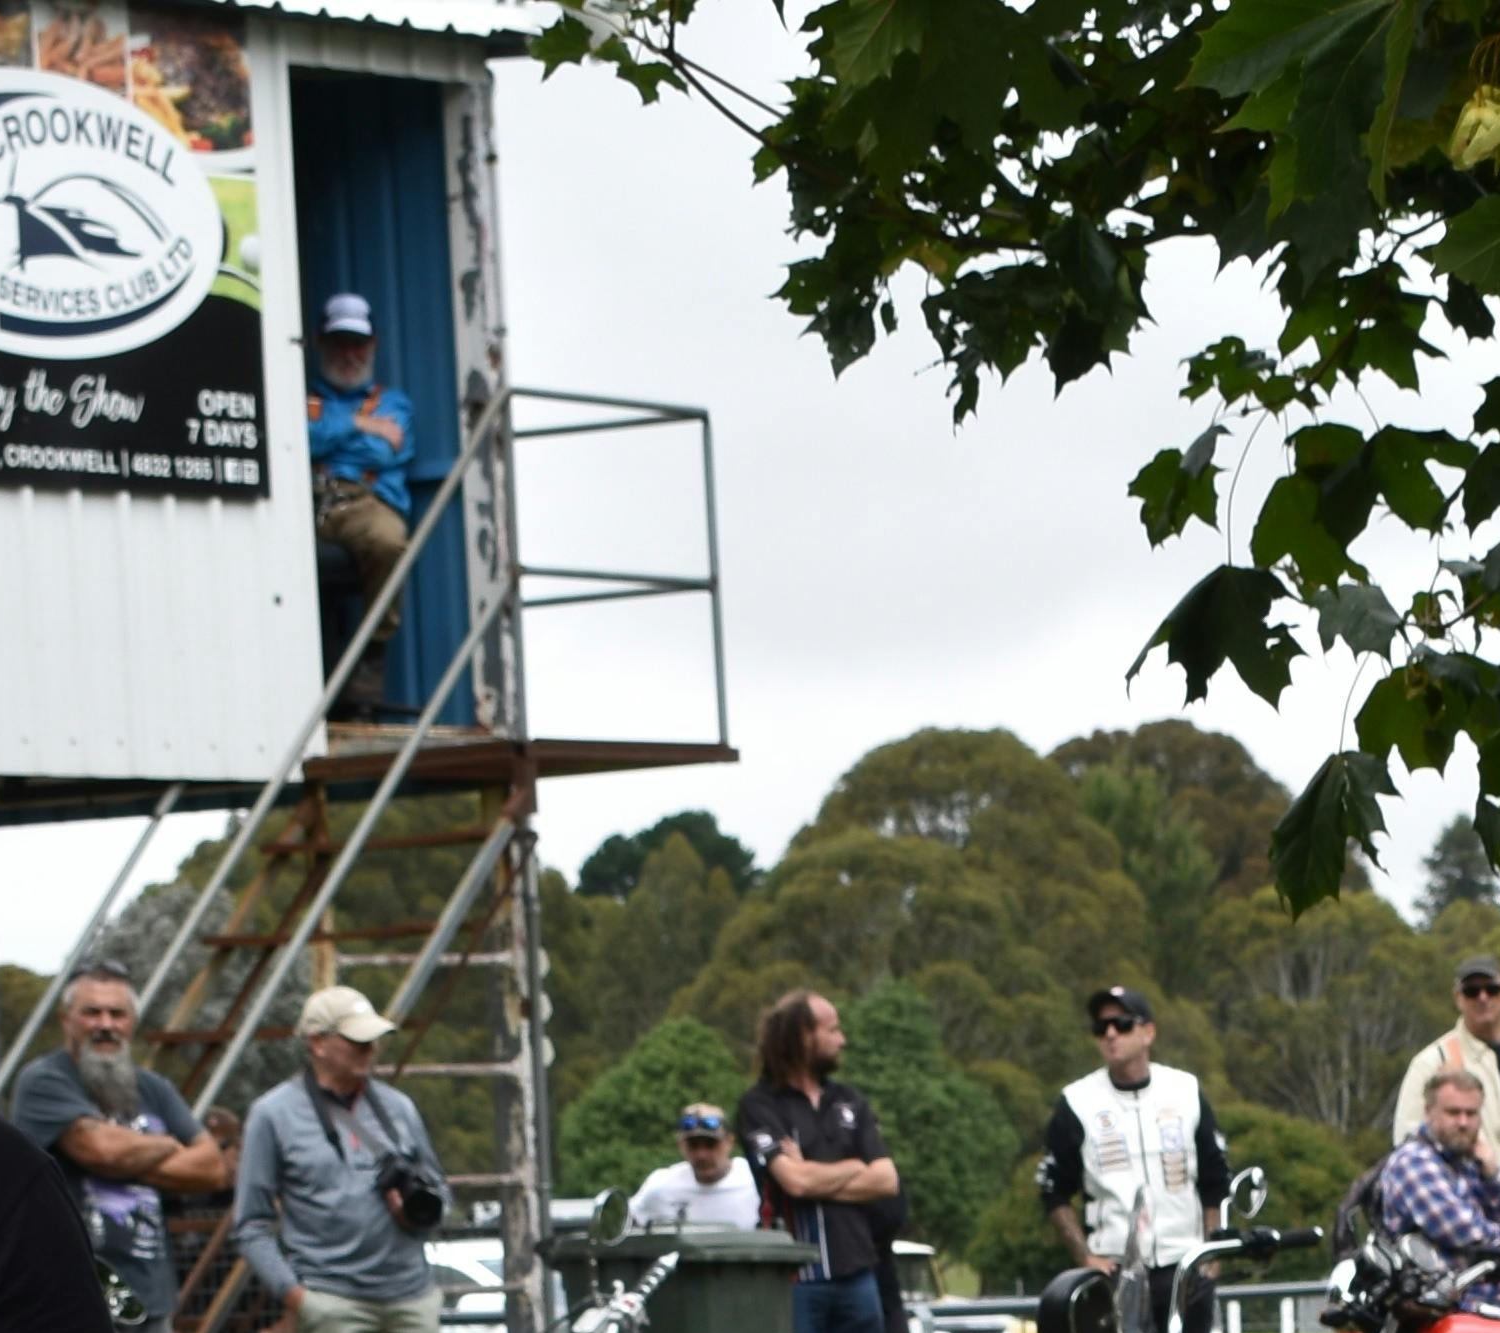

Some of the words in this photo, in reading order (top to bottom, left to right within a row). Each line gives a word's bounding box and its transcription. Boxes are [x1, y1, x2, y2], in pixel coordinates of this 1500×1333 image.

[105, 269, 159, 312] CLUB
[159, 236, 193, 280] LTD
[24, 369, 65, 416] the
[70, 373, 145, 428] Show
[198, 389, 255, 418] OPEN
[186, 418, 199, 444] 7
[203, 419, 258, 449] DAYS
[4, 443, 120, 474] CROOKWELL
